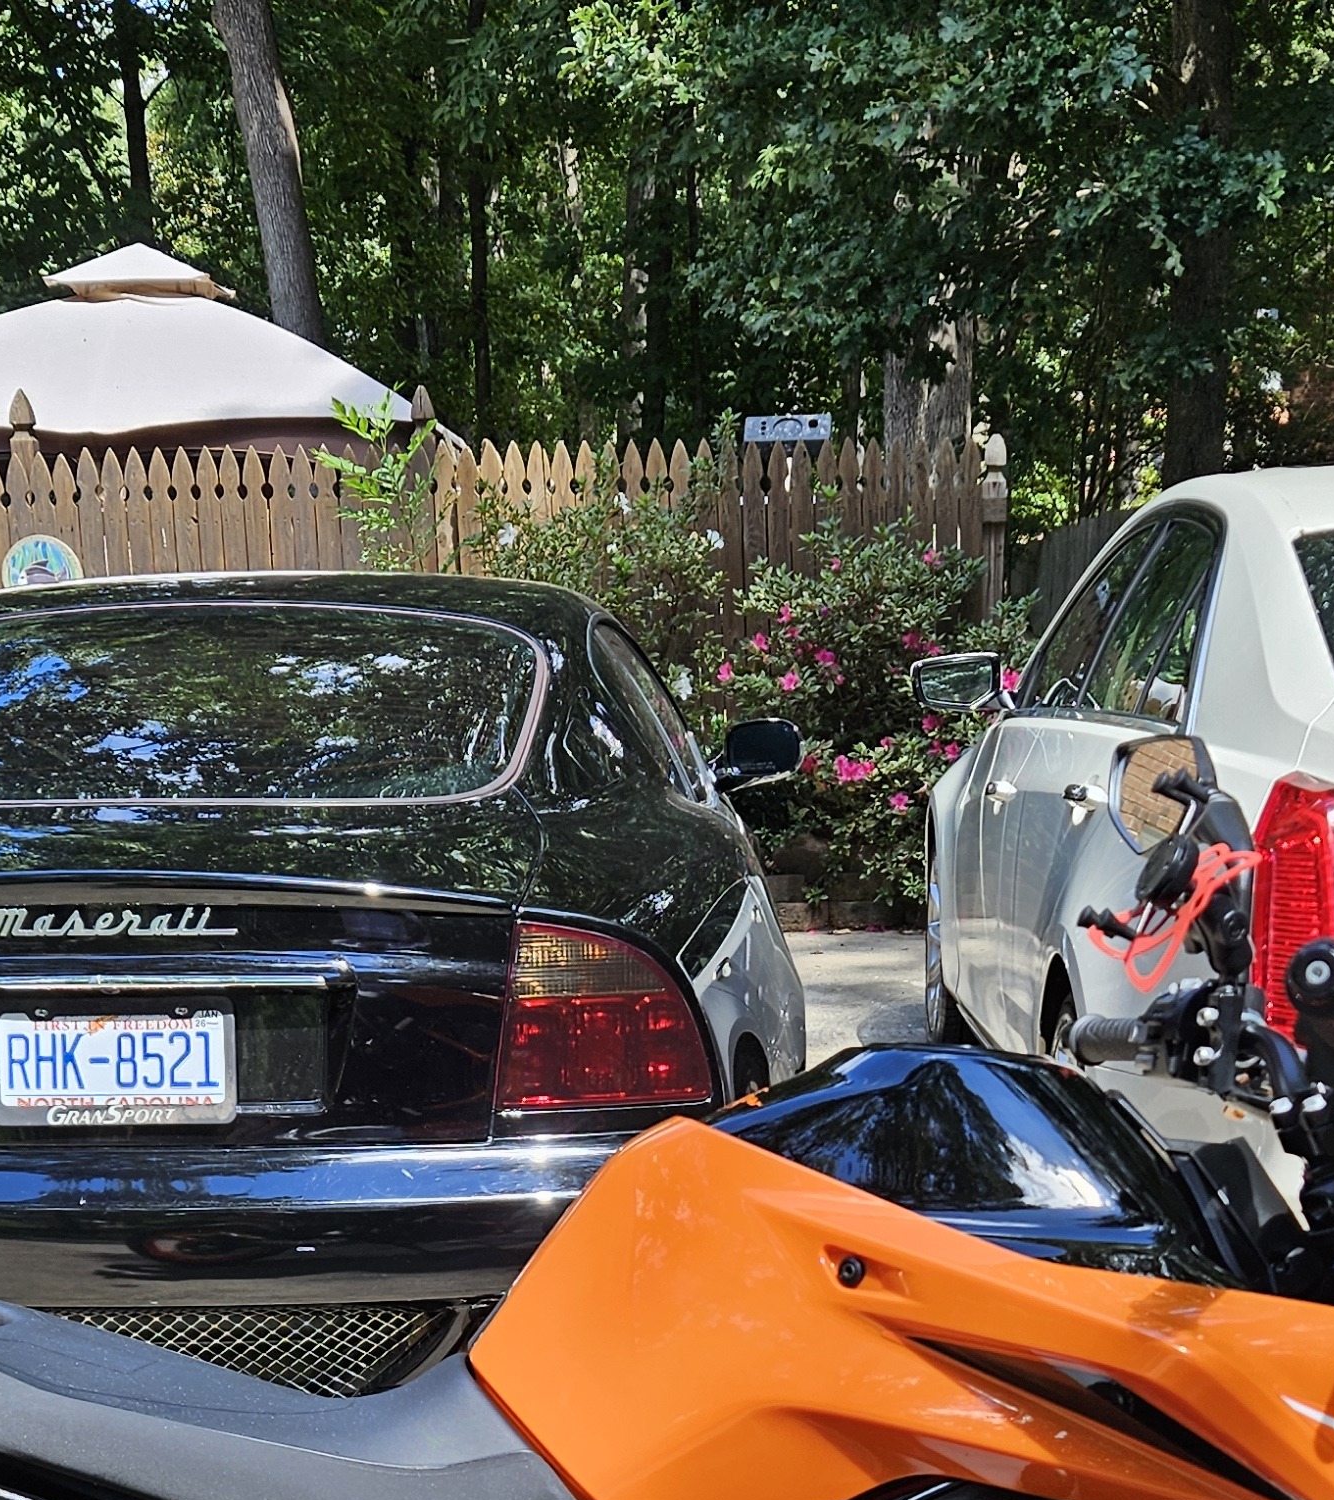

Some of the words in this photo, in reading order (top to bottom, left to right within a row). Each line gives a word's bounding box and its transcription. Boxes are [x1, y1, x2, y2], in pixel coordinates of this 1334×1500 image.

[33, 1020, 75, 1031] FIRST
[114, 1019, 193, 1031] FREEDOM
[195, 1019, 206, 1028] 26
[7, 1031, 221, 1090] RHK-8521
